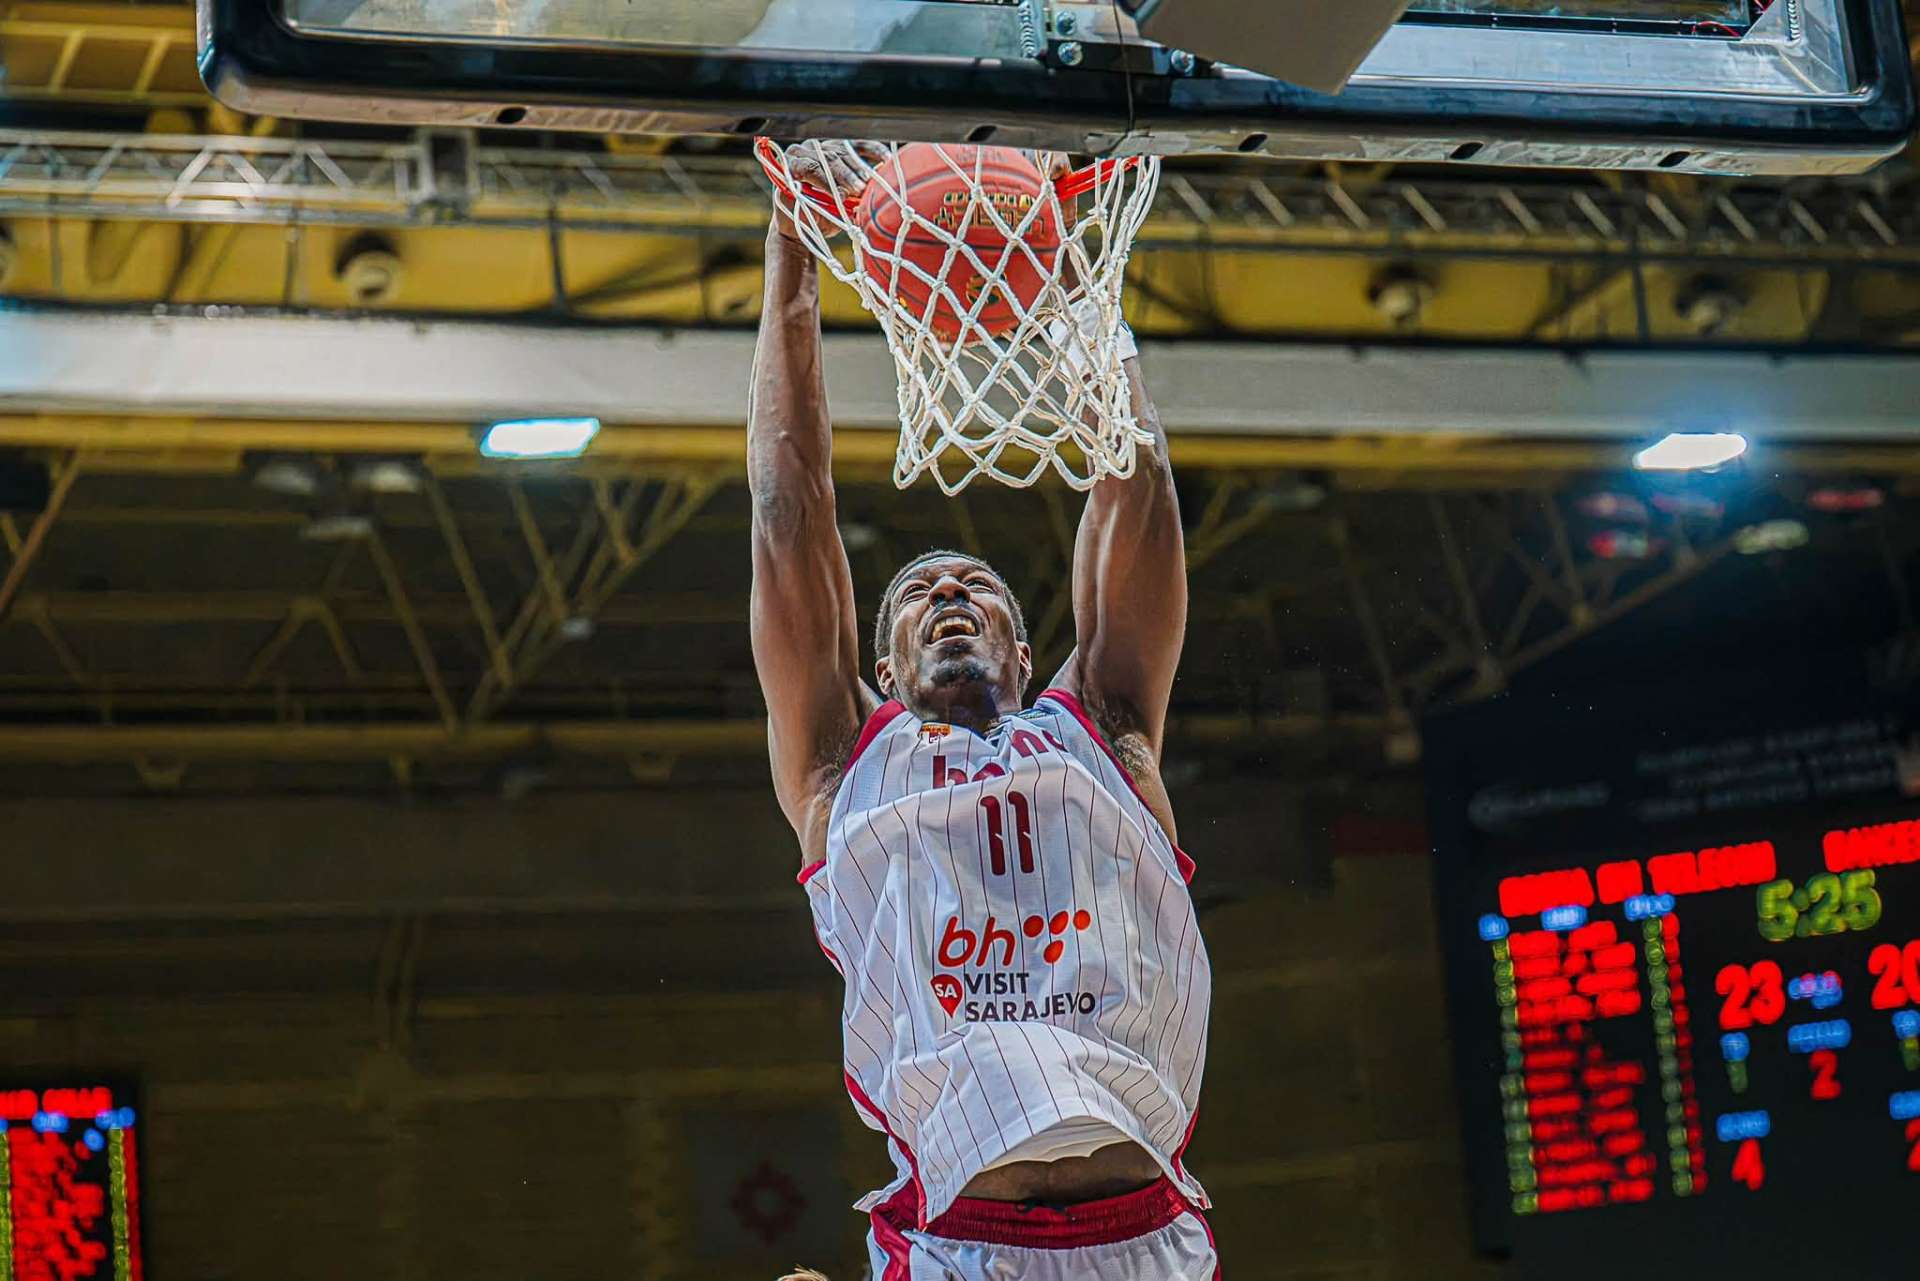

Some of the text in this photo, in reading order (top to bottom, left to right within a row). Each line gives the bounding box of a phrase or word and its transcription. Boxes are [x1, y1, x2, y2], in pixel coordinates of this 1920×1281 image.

[980, 790, 1035, 876] 11
[1757, 869, 1882, 942] 5:25
[938, 916, 1016, 967] bh
[934, 984, 958, 998] SA
[964, 973, 1029, 995] VISIT
[965, 992, 1096, 1022] SARAJEVO
[1715, 960, 1786, 1030] 23
[1809, 1048, 1842, 1101] 2
